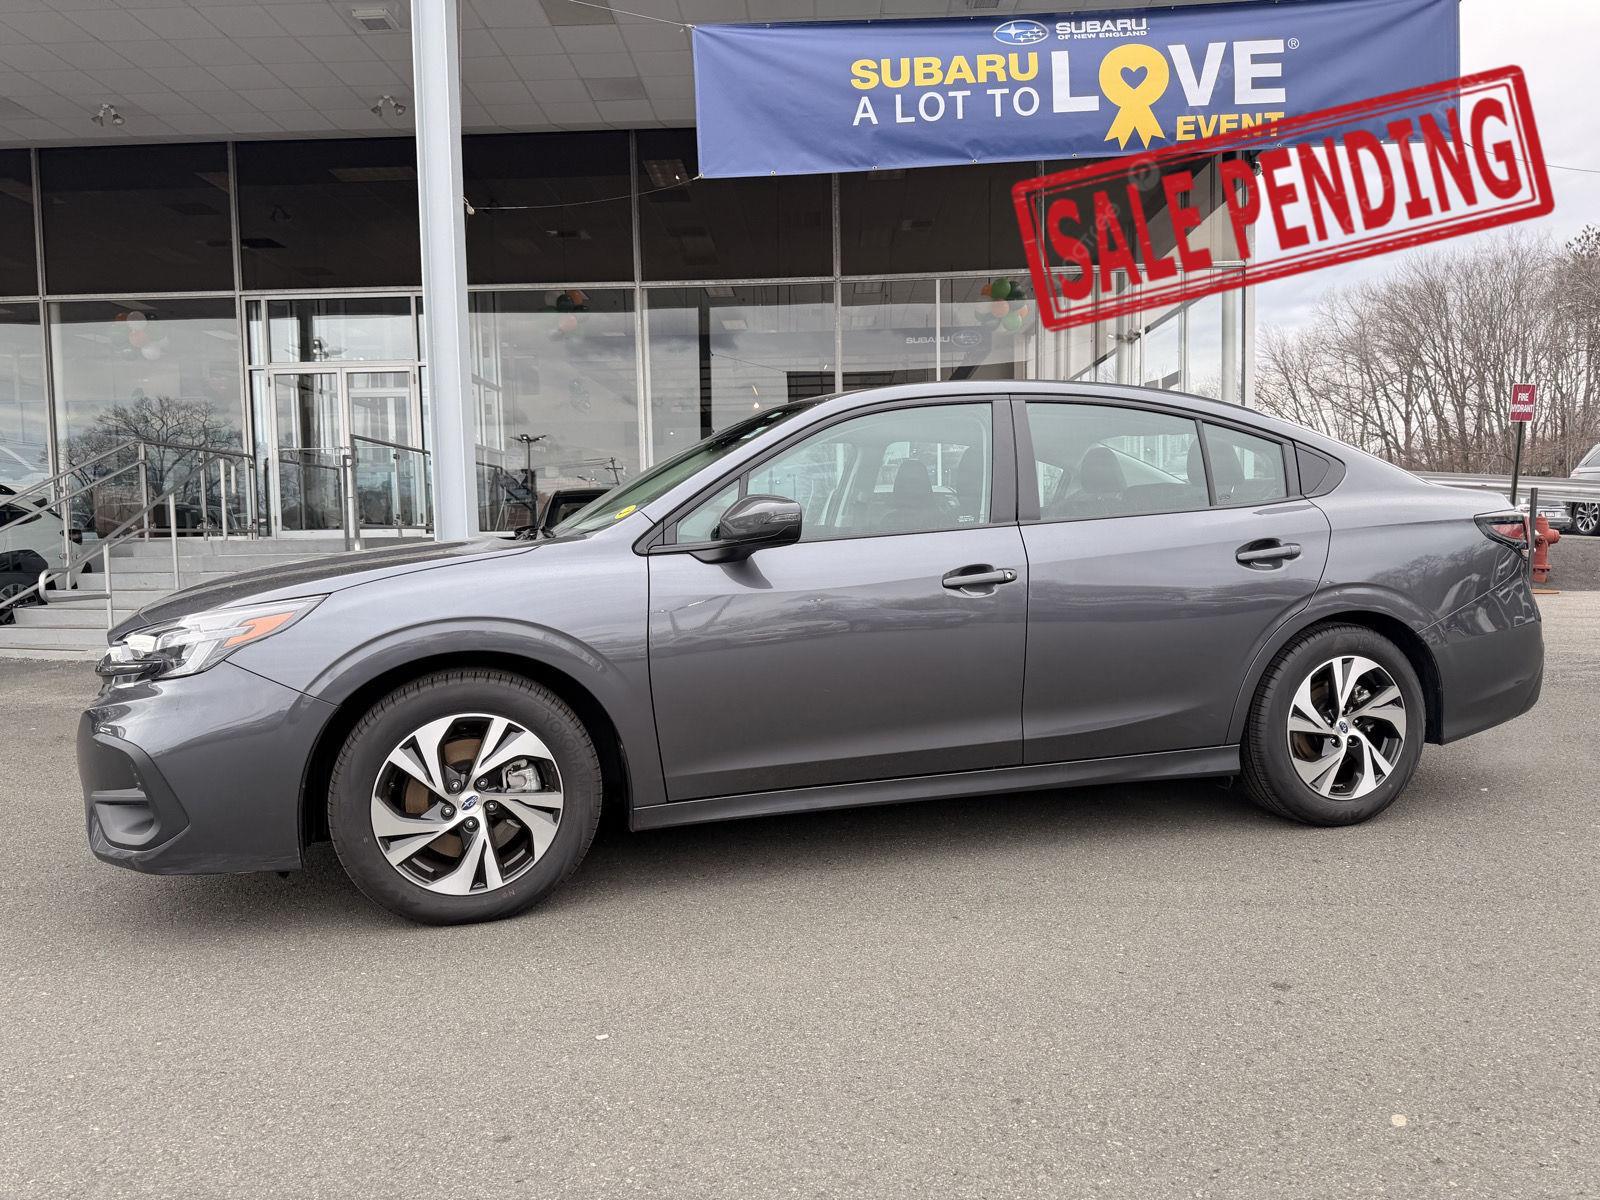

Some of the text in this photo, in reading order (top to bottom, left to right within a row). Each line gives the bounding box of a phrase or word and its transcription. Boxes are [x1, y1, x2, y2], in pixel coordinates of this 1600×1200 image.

[1055, 18, 1148, 34] SUBARU
[1098, 30, 1148, 38] ENGLAND
[850, 52, 1039, 90] SUBARU
[852, 86, 1040, 126] A LOT TO
[1176, 112, 1285, 141] EVENT
